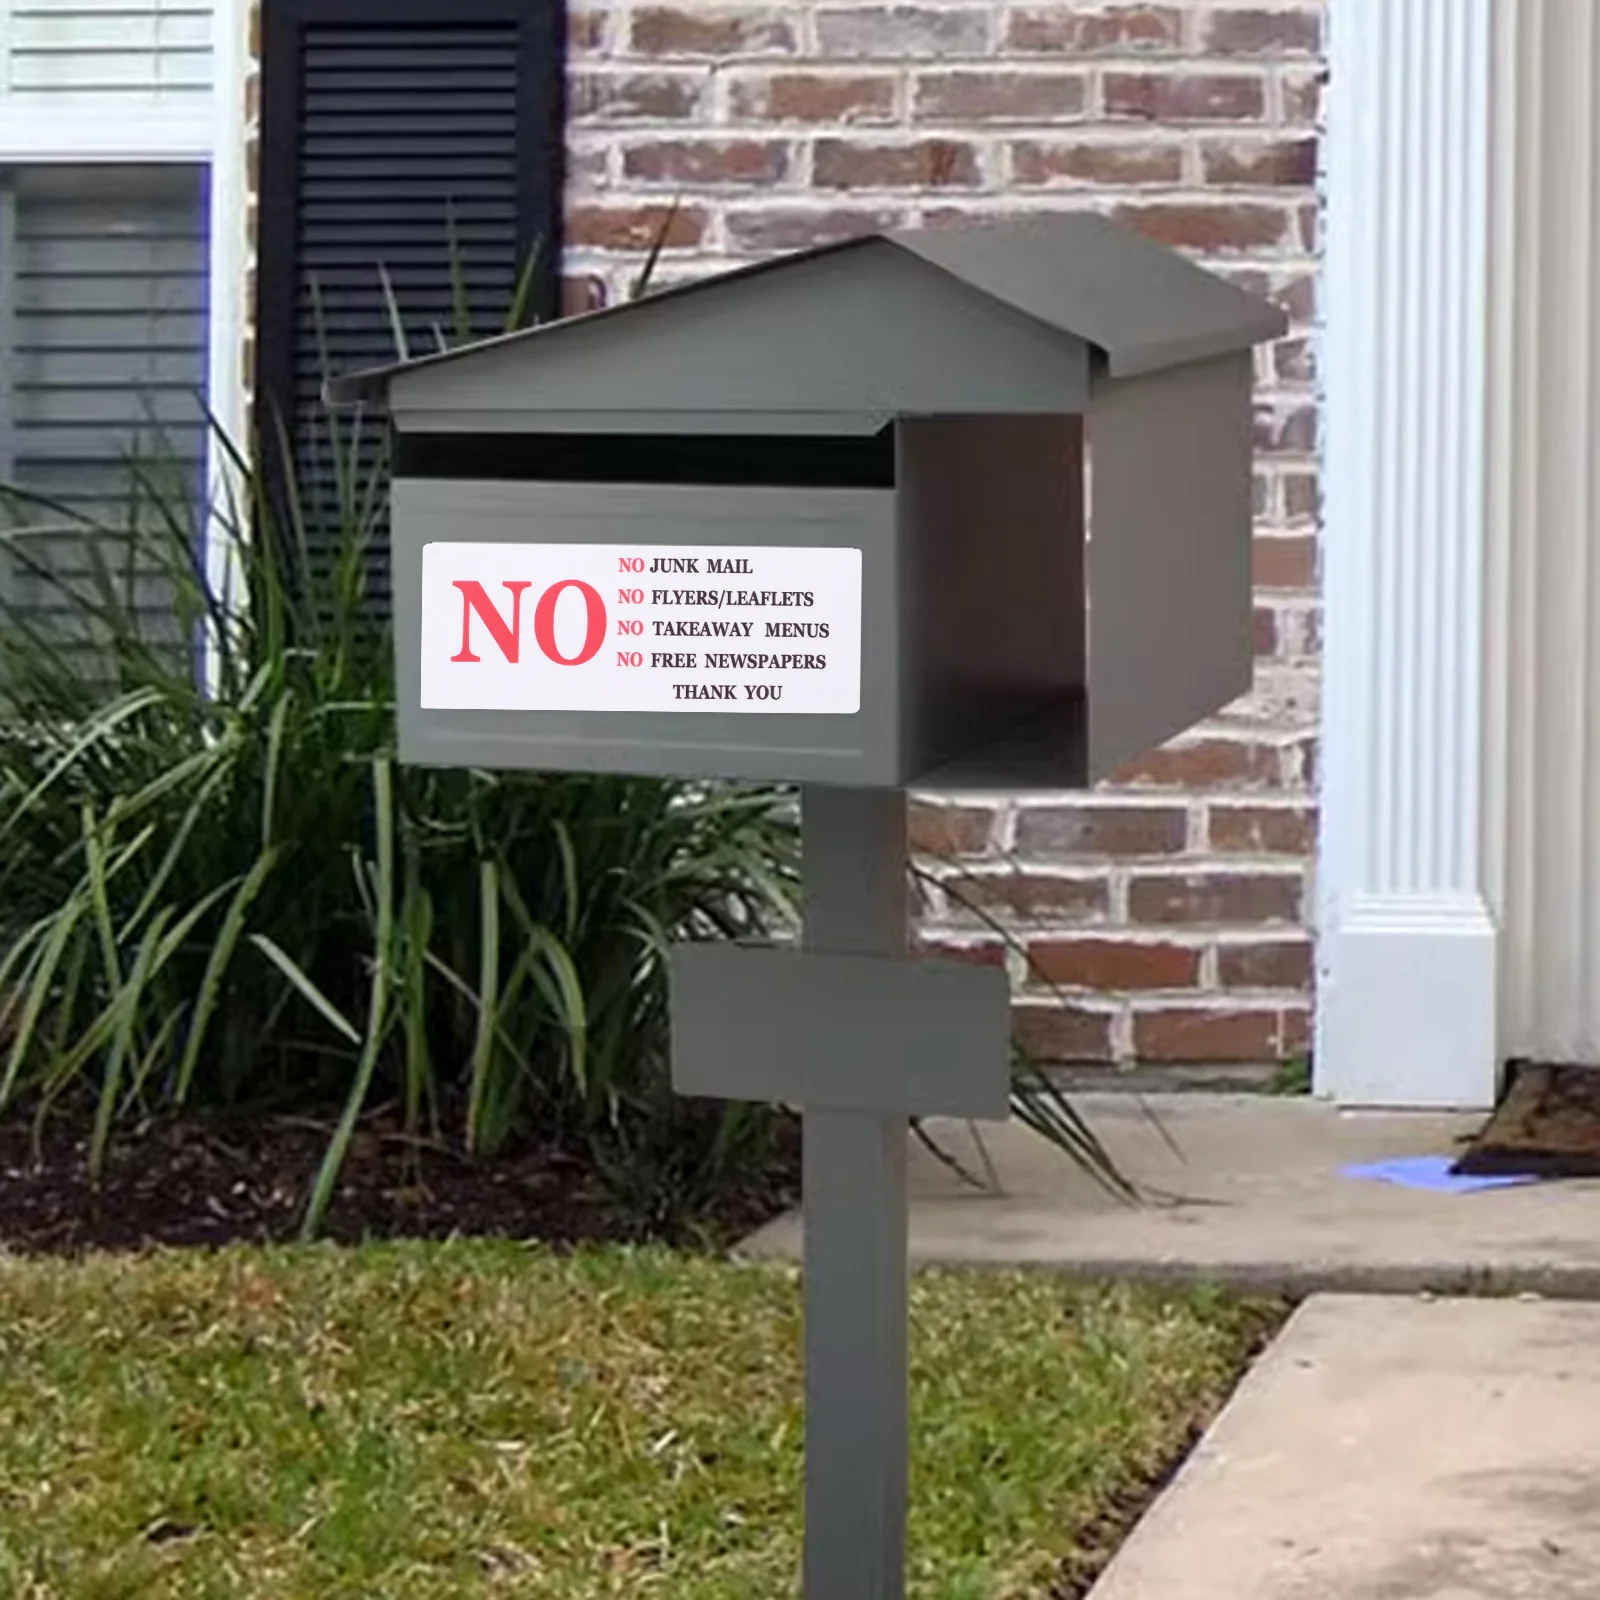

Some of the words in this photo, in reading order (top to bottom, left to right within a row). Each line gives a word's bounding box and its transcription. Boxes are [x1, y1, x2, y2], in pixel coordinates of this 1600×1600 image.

[618, 557, 645, 573] NO
[649, 557, 700, 574] JUNK
[706, 558, 754, 574] MAIL
[617, 588, 645, 604] NO
[651, 589, 814, 609] FLYERS/LEAFLETS
[450, 579, 608, 667] NO
[617, 620, 644, 636] NO
[652, 621, 755, 637] TAKEAWAY
[764, 622, 830, 639] MENUS
[616, 651, 644, 667] NO
[650, 652, 697, 669] FREE
[704, 653, 827, 670] NEWSPAPERS
[672, 684, 738, 700] THANK
[743, 684, 784, 701] YOU
